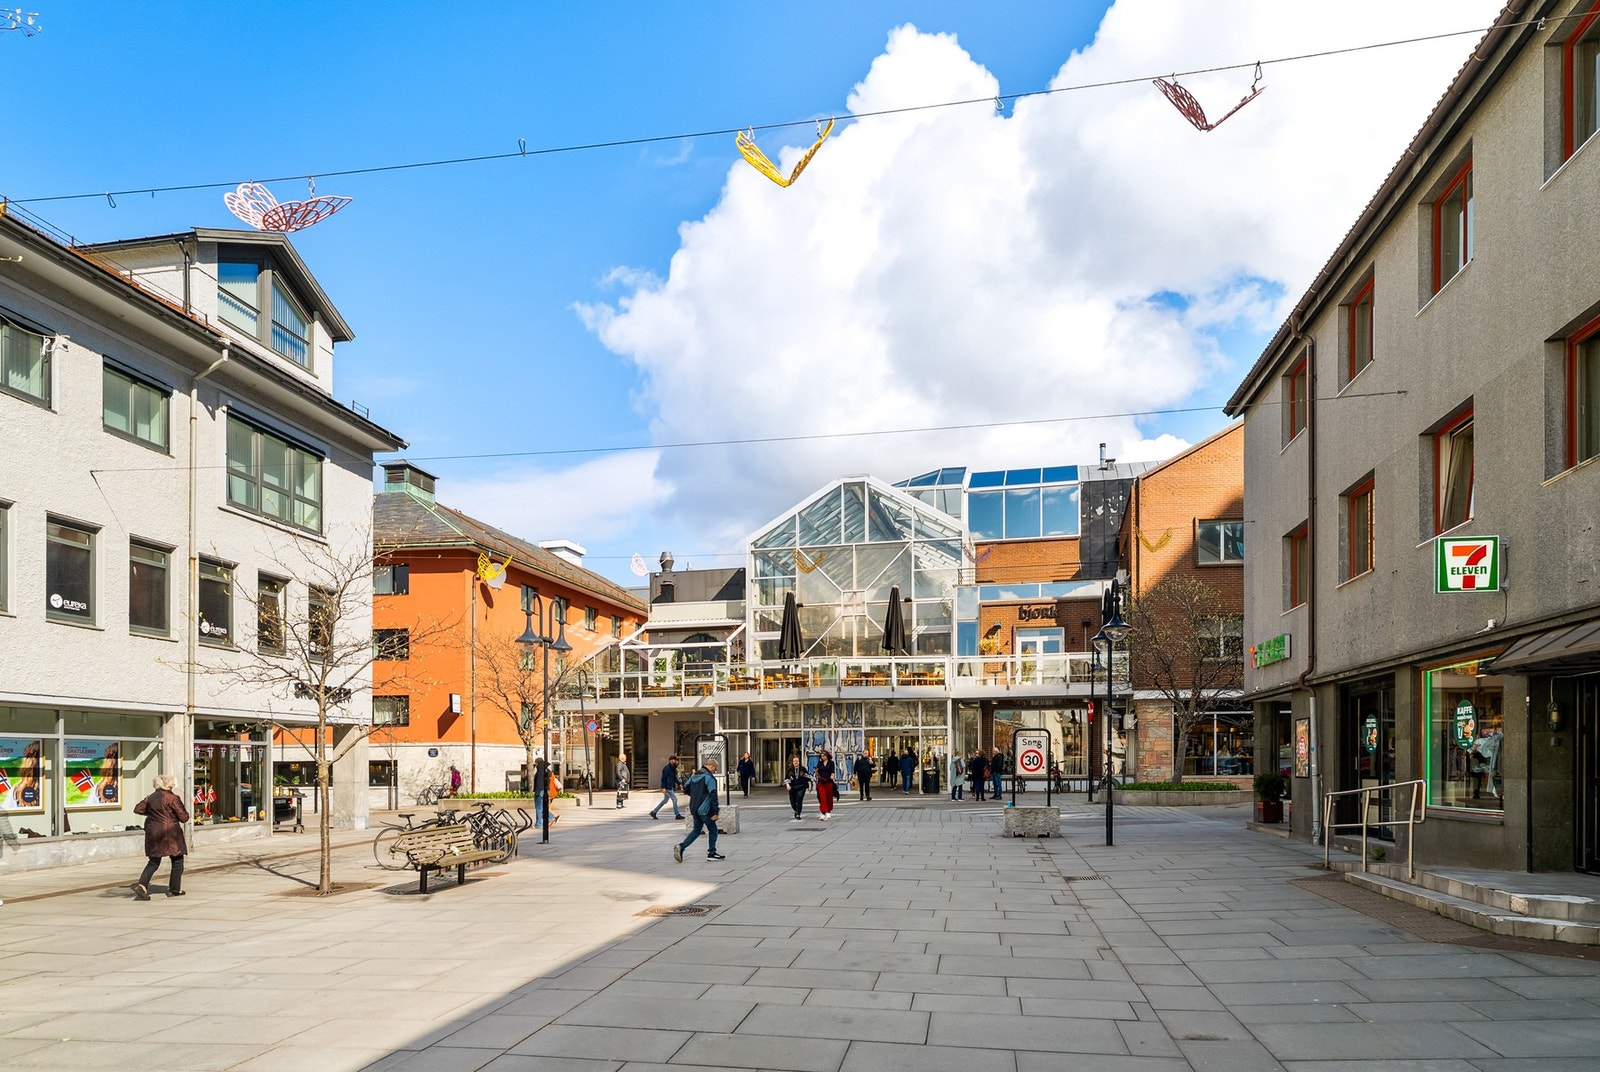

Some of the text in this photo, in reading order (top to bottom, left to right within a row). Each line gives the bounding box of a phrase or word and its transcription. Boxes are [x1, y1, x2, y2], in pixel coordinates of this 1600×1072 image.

[1452, 545, 1487, 589] 7
[63, 600, 87, 610] eureka
[1457, 706, 1473, 715] KAFFE
[1024, 755, 1039, 766] 30
